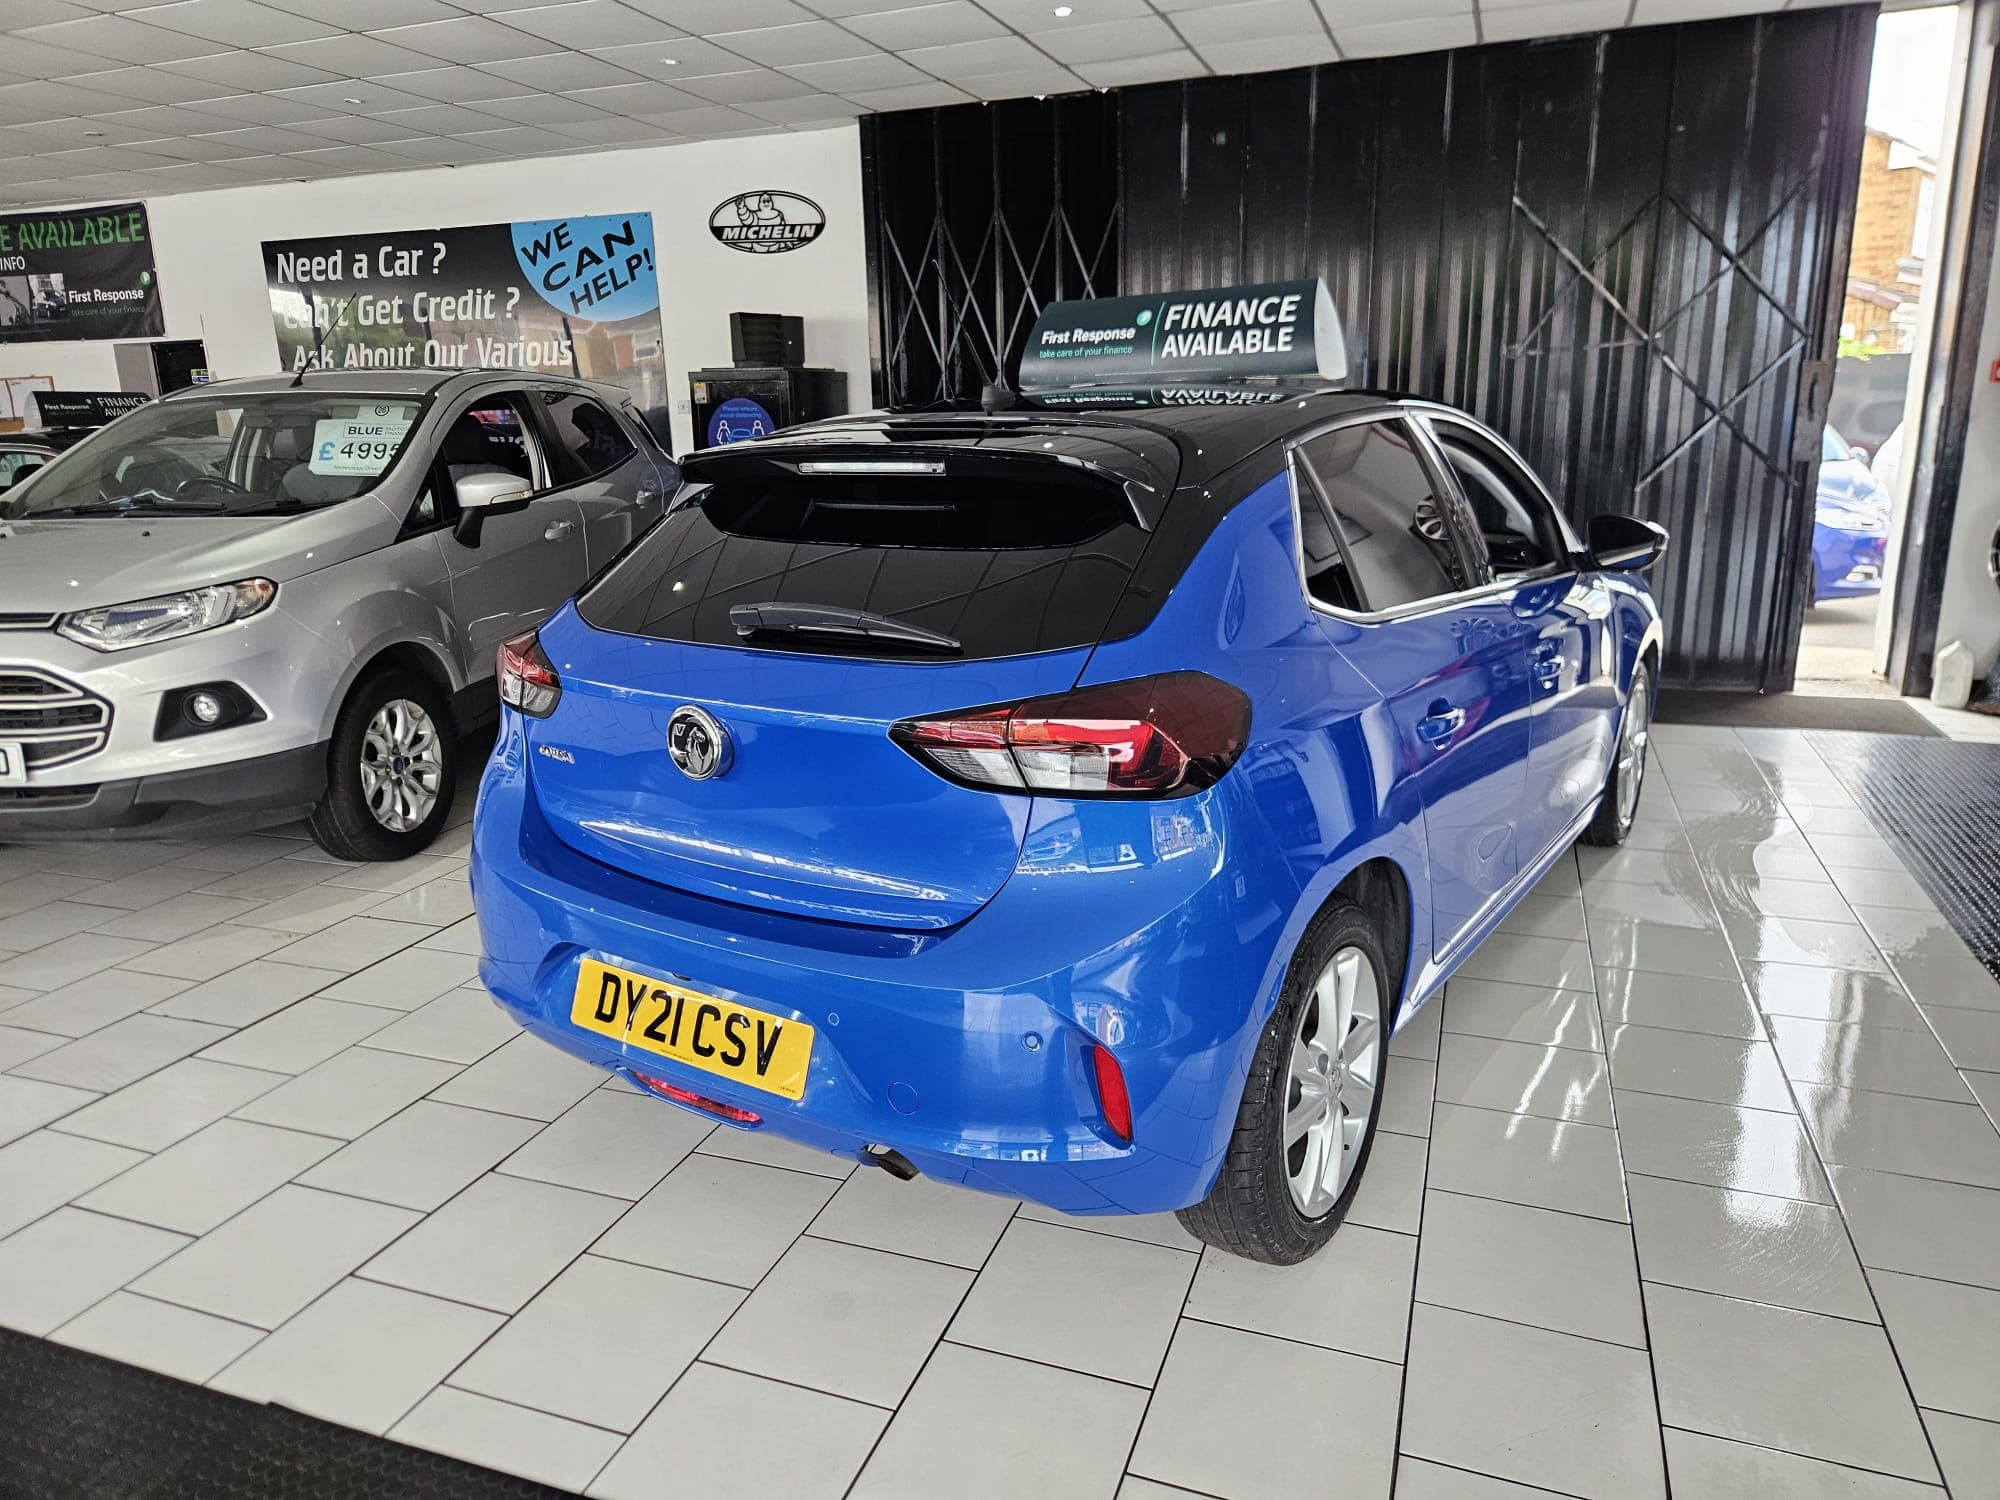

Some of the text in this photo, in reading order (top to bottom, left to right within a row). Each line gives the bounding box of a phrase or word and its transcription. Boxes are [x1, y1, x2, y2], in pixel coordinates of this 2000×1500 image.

[19, 213, 145, 251] AVAILABLE
[521, 222, 573, 267] WE
[722, 224, 816, 240] MICHELIN
[0, 256, 26, 271] INFO
[277, 250, 343, 284] Need
[353, 253, 368, 279] a
[379, 246, 423, 277] Car
[543, 220, 635, 291] CAN
[69, 289, 144, 303] First Response
[569, 248, 654, 314] HELP!
[284, 298, 349, 328] Can't
[358, 294, 403, 325] Get
[413, 288, 495, 323] Credit
[1164, 294, 1301, 331] FINANCE
[1040, 345, 1134, 358] take care of your finance
[1042, 327, 1136, 344] First Response
[1161, 327, 1294, 358] AVAILABLE
[293, 335, 572, 371] Ask About Our Various
[97, 397, 147, 407] FINANCE
[348, 426, 383, 435] BLUE
